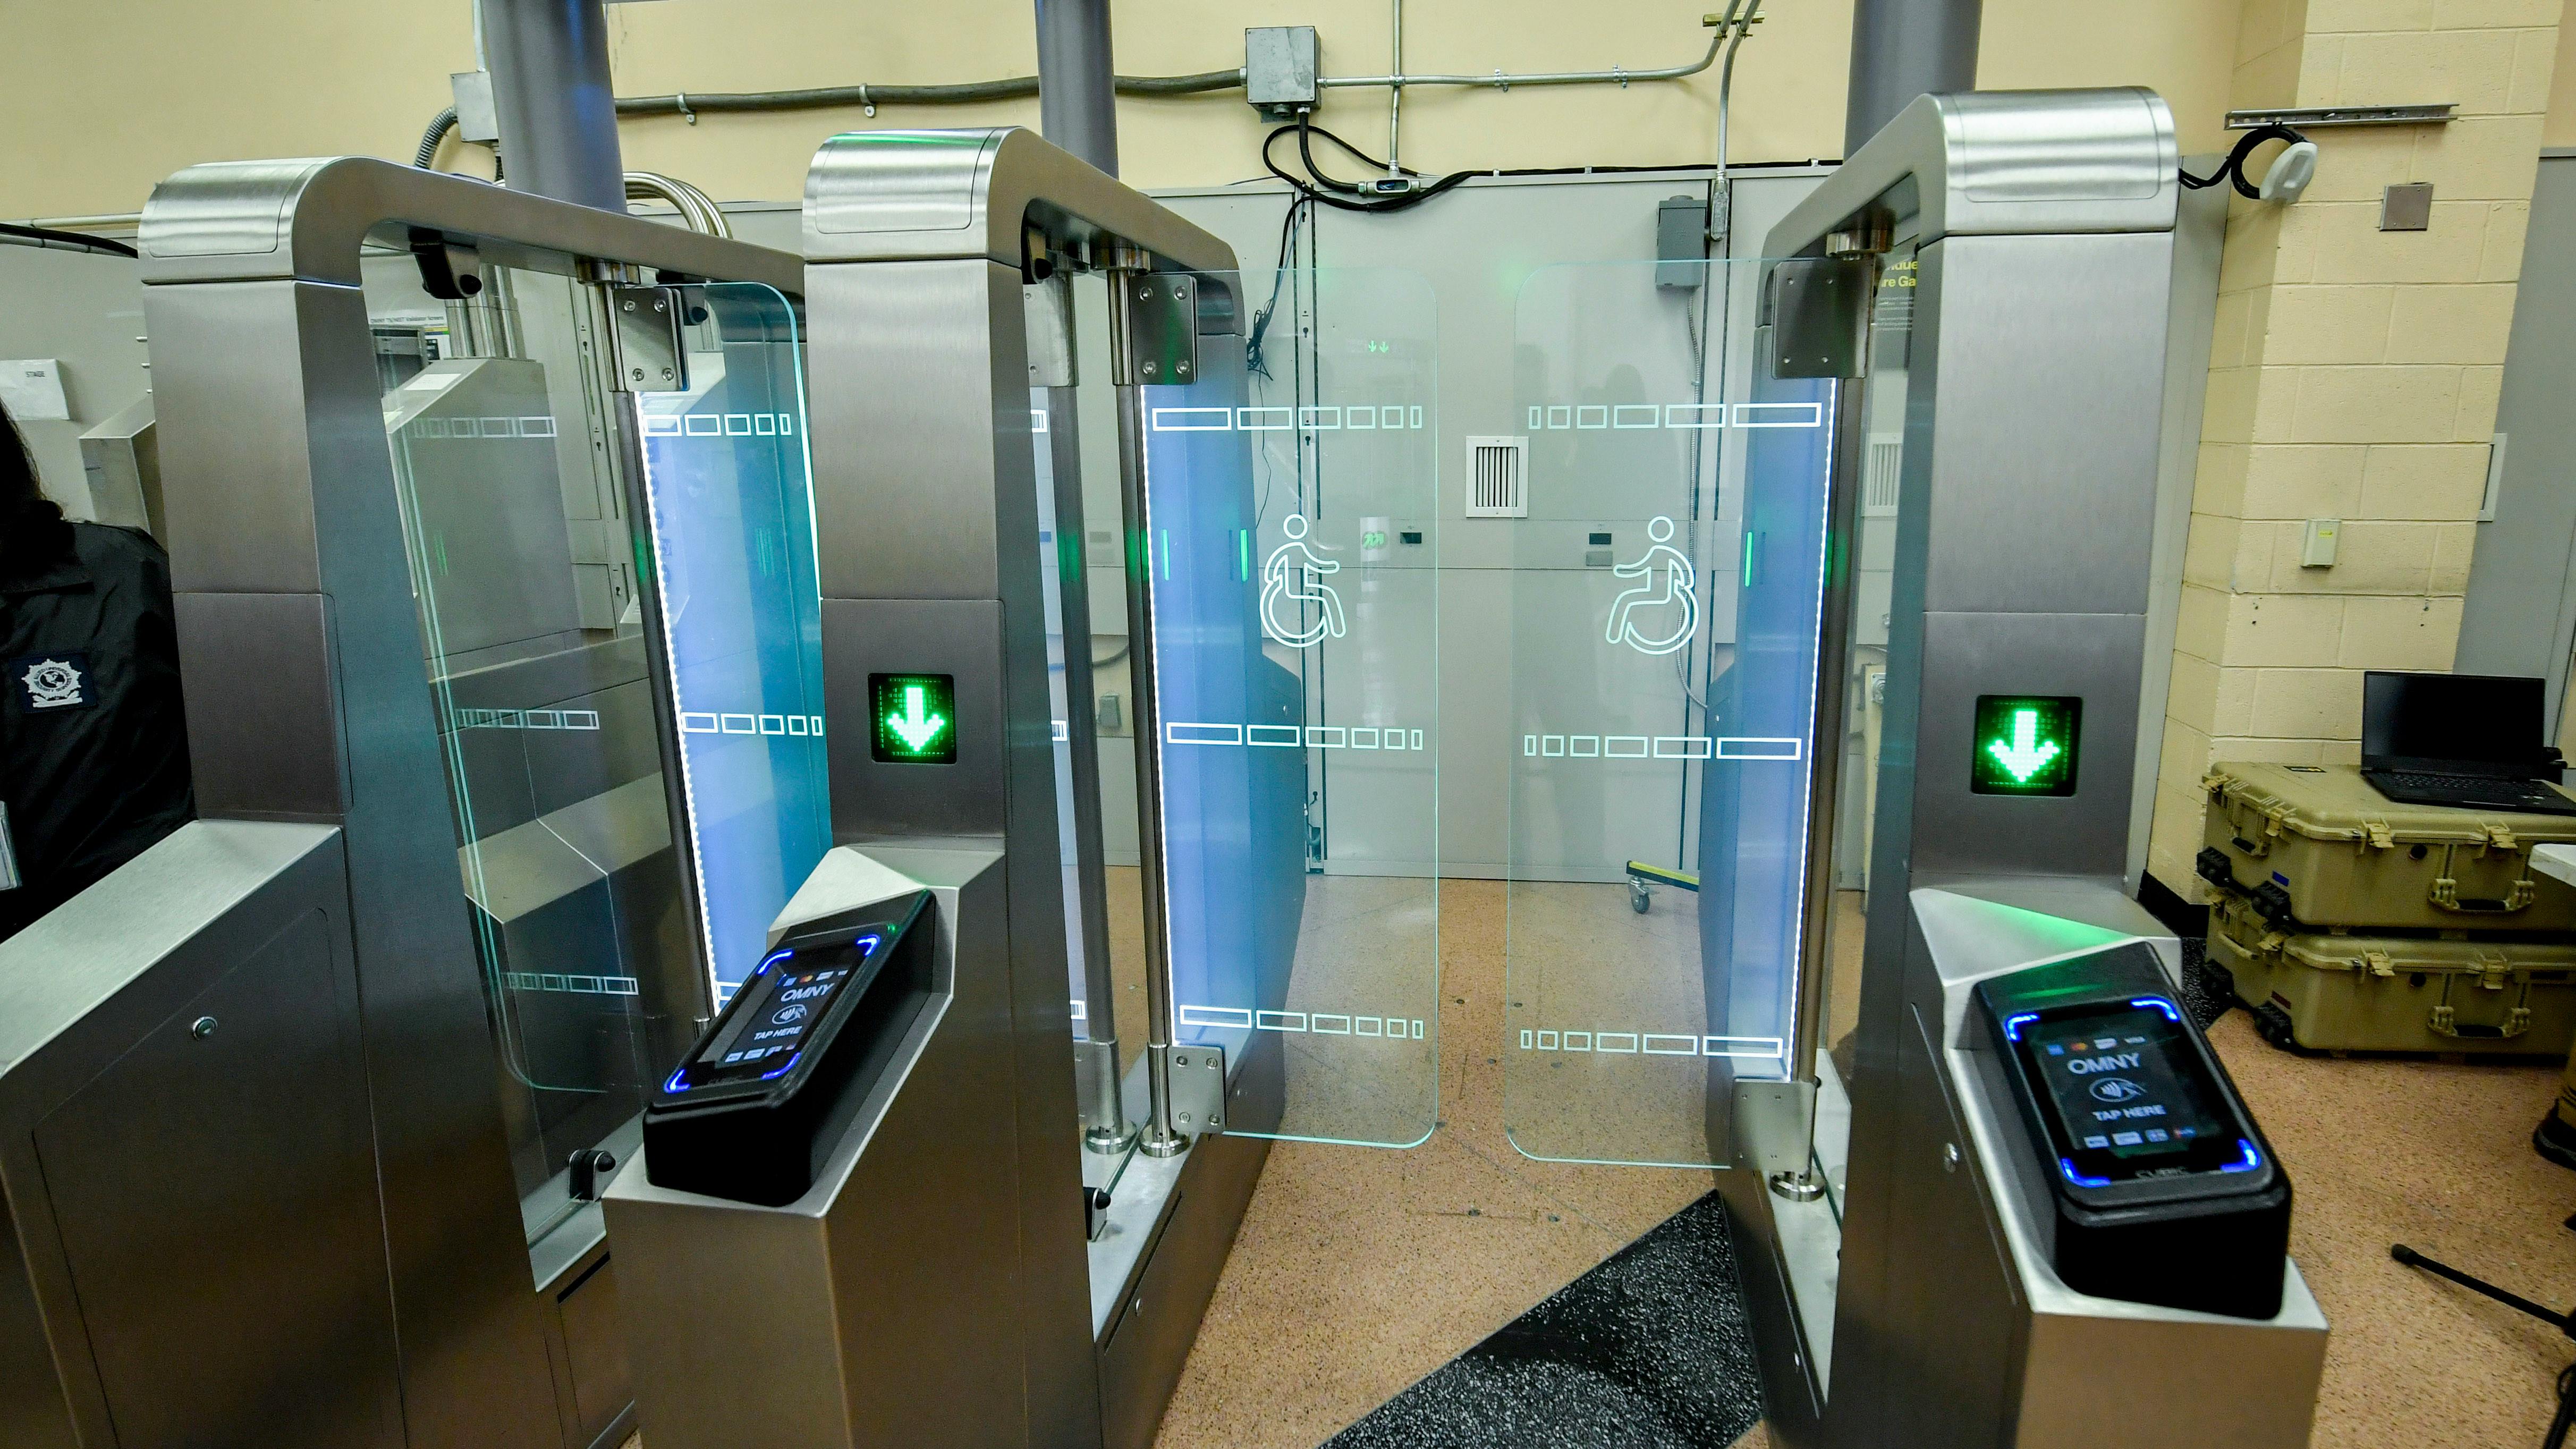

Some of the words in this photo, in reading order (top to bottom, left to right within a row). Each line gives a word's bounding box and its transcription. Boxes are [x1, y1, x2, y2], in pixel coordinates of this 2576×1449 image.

[1881, 278, 1896, 287] re
[1898, 275, 1917, 287] Ga
[781, 983, 835, 1002] OMNY
[754, 1030, 774, 1040] TAP
[773, 1026, 803, 1037] HERE
[2067, 1053, 2139, 1074] OMNY
[2092, 1109, 2122, 1121] TAP
[2122, 1105, 2166, 1117] HERE
